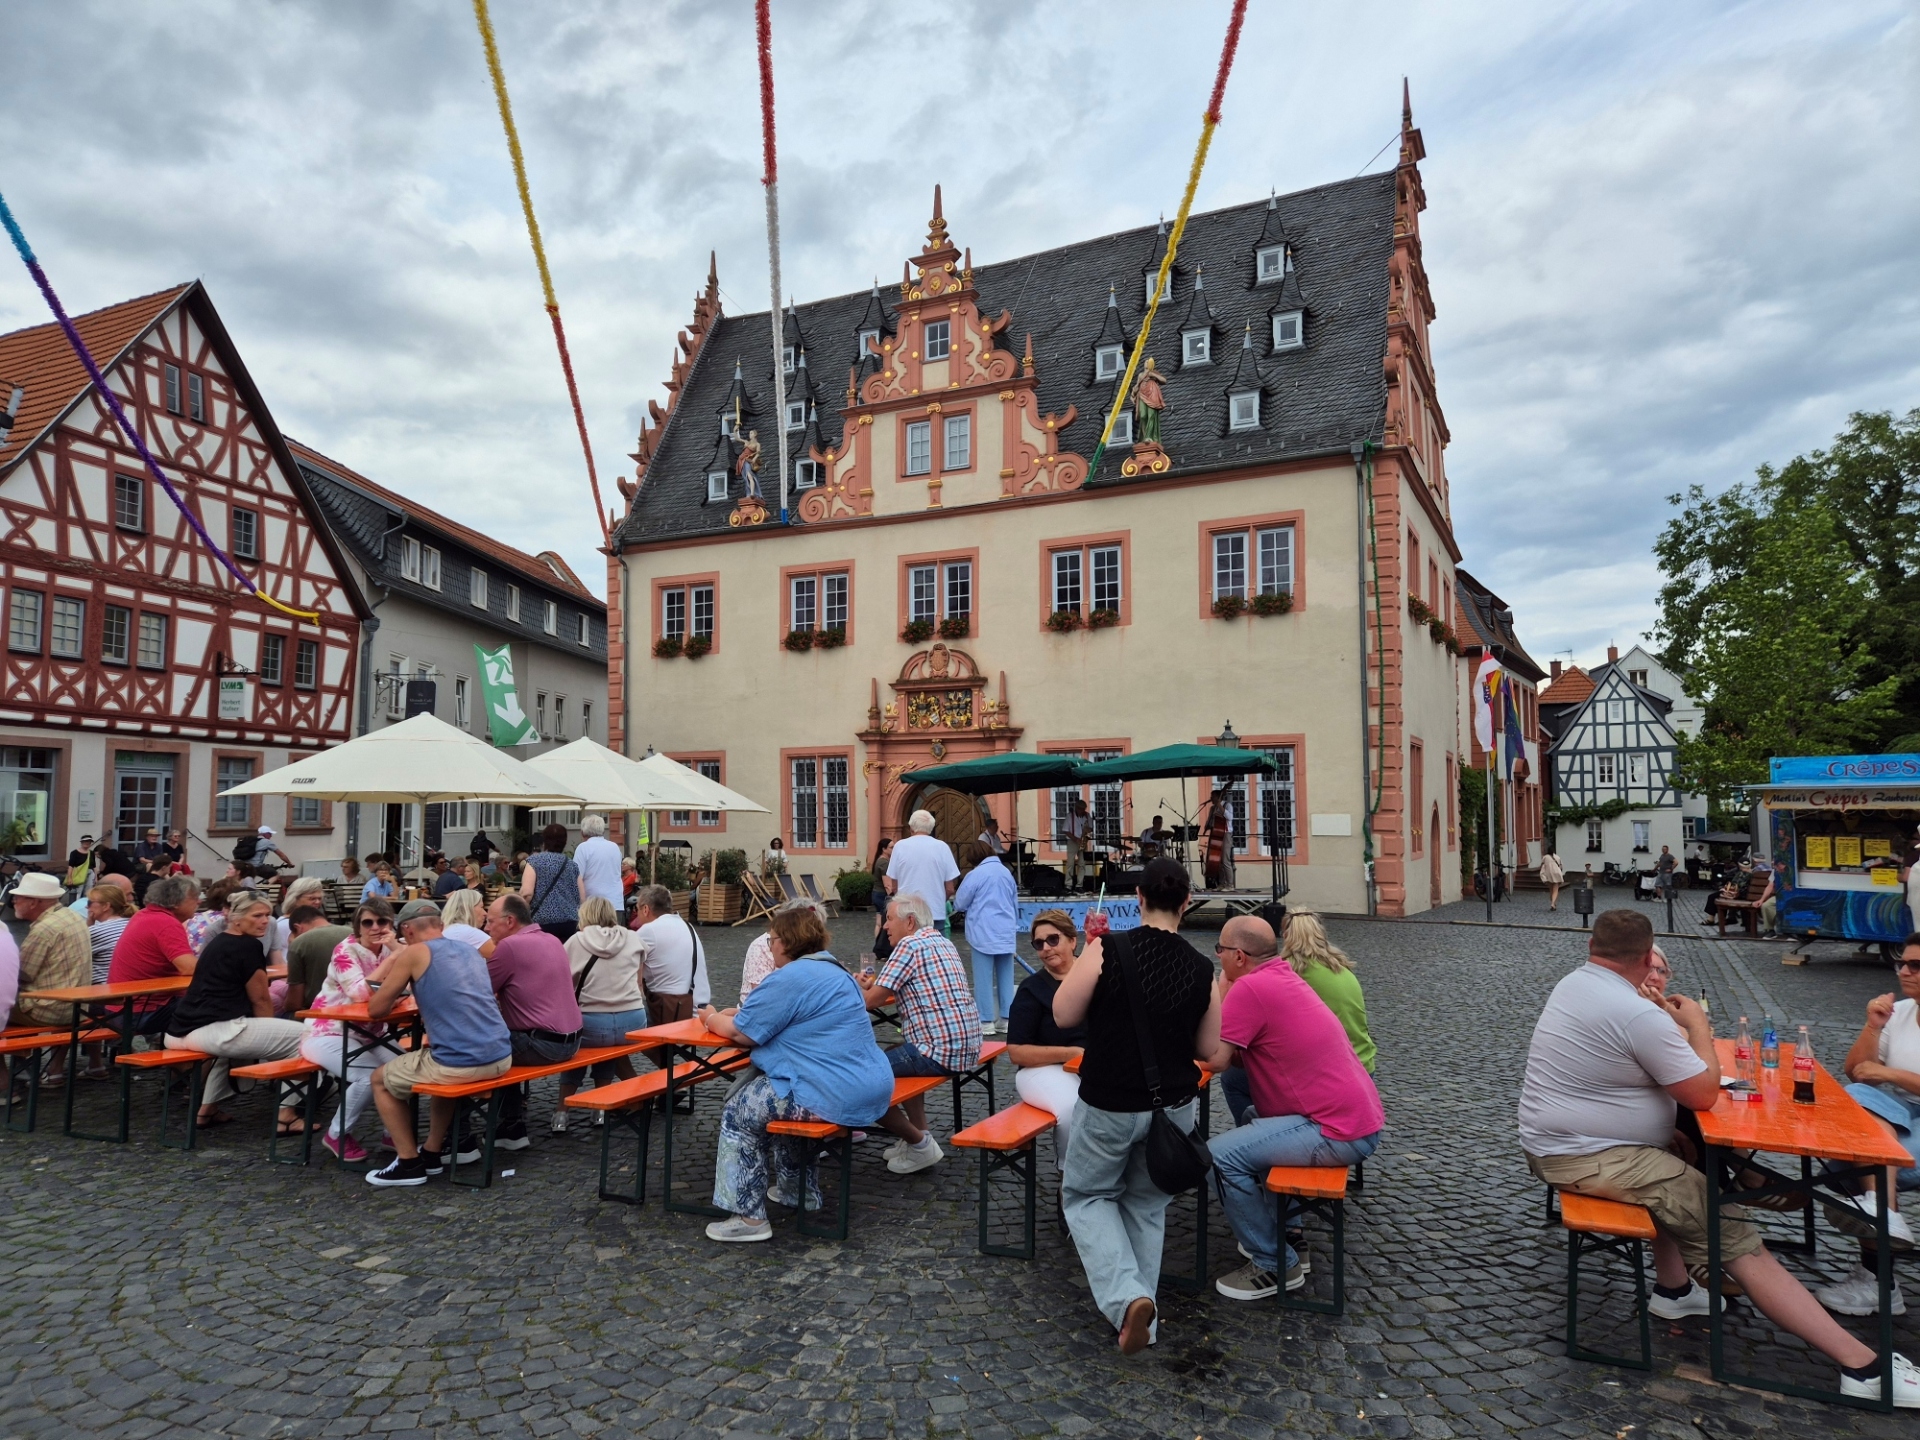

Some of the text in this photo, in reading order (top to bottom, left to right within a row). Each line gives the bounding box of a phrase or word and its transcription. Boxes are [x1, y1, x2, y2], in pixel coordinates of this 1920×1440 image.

[529, 730, 538, 741] 4
[1872, 792, 1920, 802] Zauberei
[1114, 922, 1135, 930] Dixie
